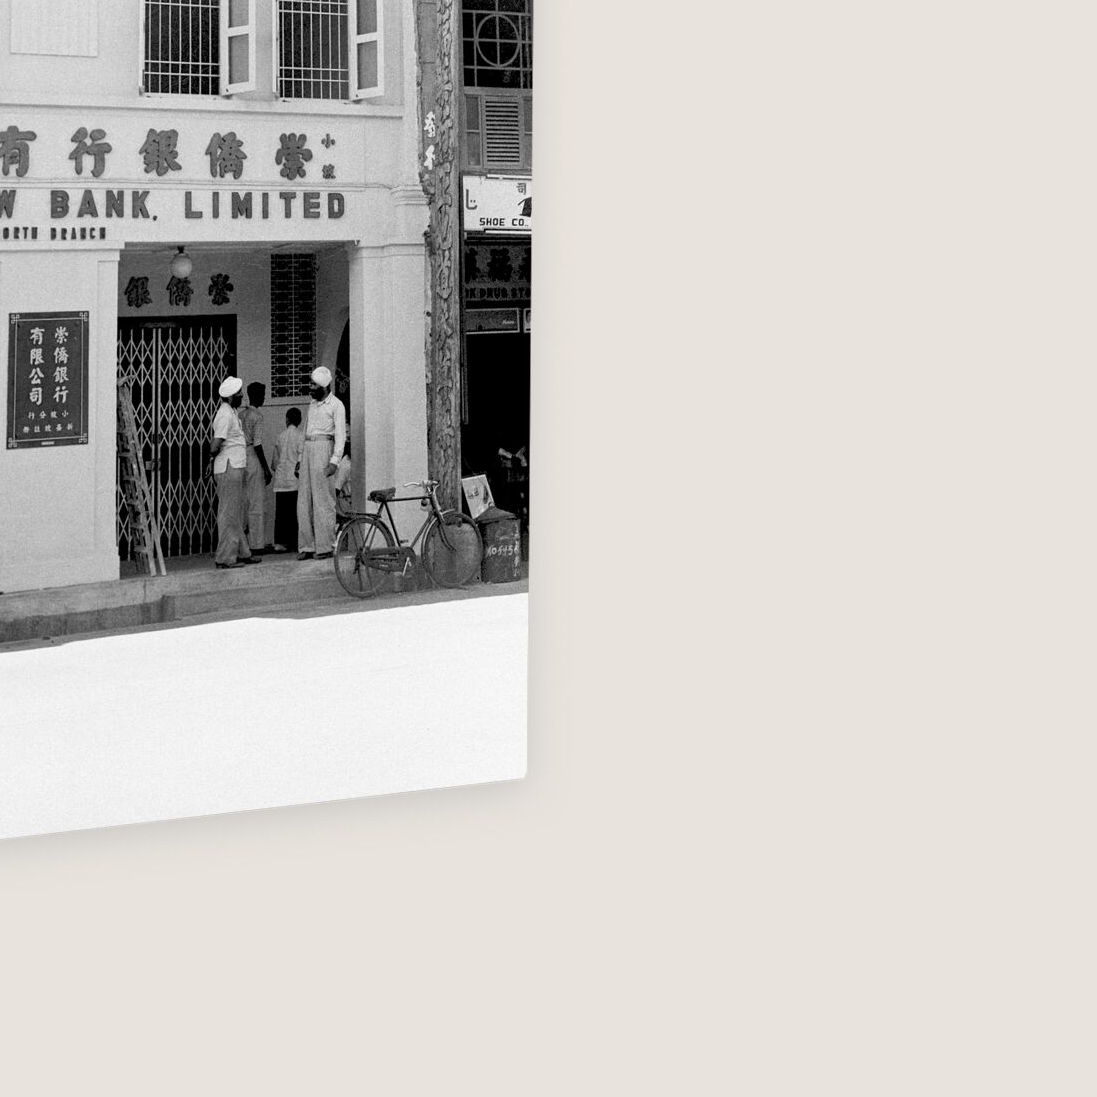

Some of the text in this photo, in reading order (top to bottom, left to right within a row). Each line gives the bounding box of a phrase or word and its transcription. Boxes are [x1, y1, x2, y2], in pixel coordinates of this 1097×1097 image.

[184, 191, 345, 219] LIMITED
[50, 227, 106, 240] BRANCH
[479, 217, 506, 227] SHOE
[29, 327, 45, 406] 有限公司
[53, 326, 69, 404] 崇僑銀行
